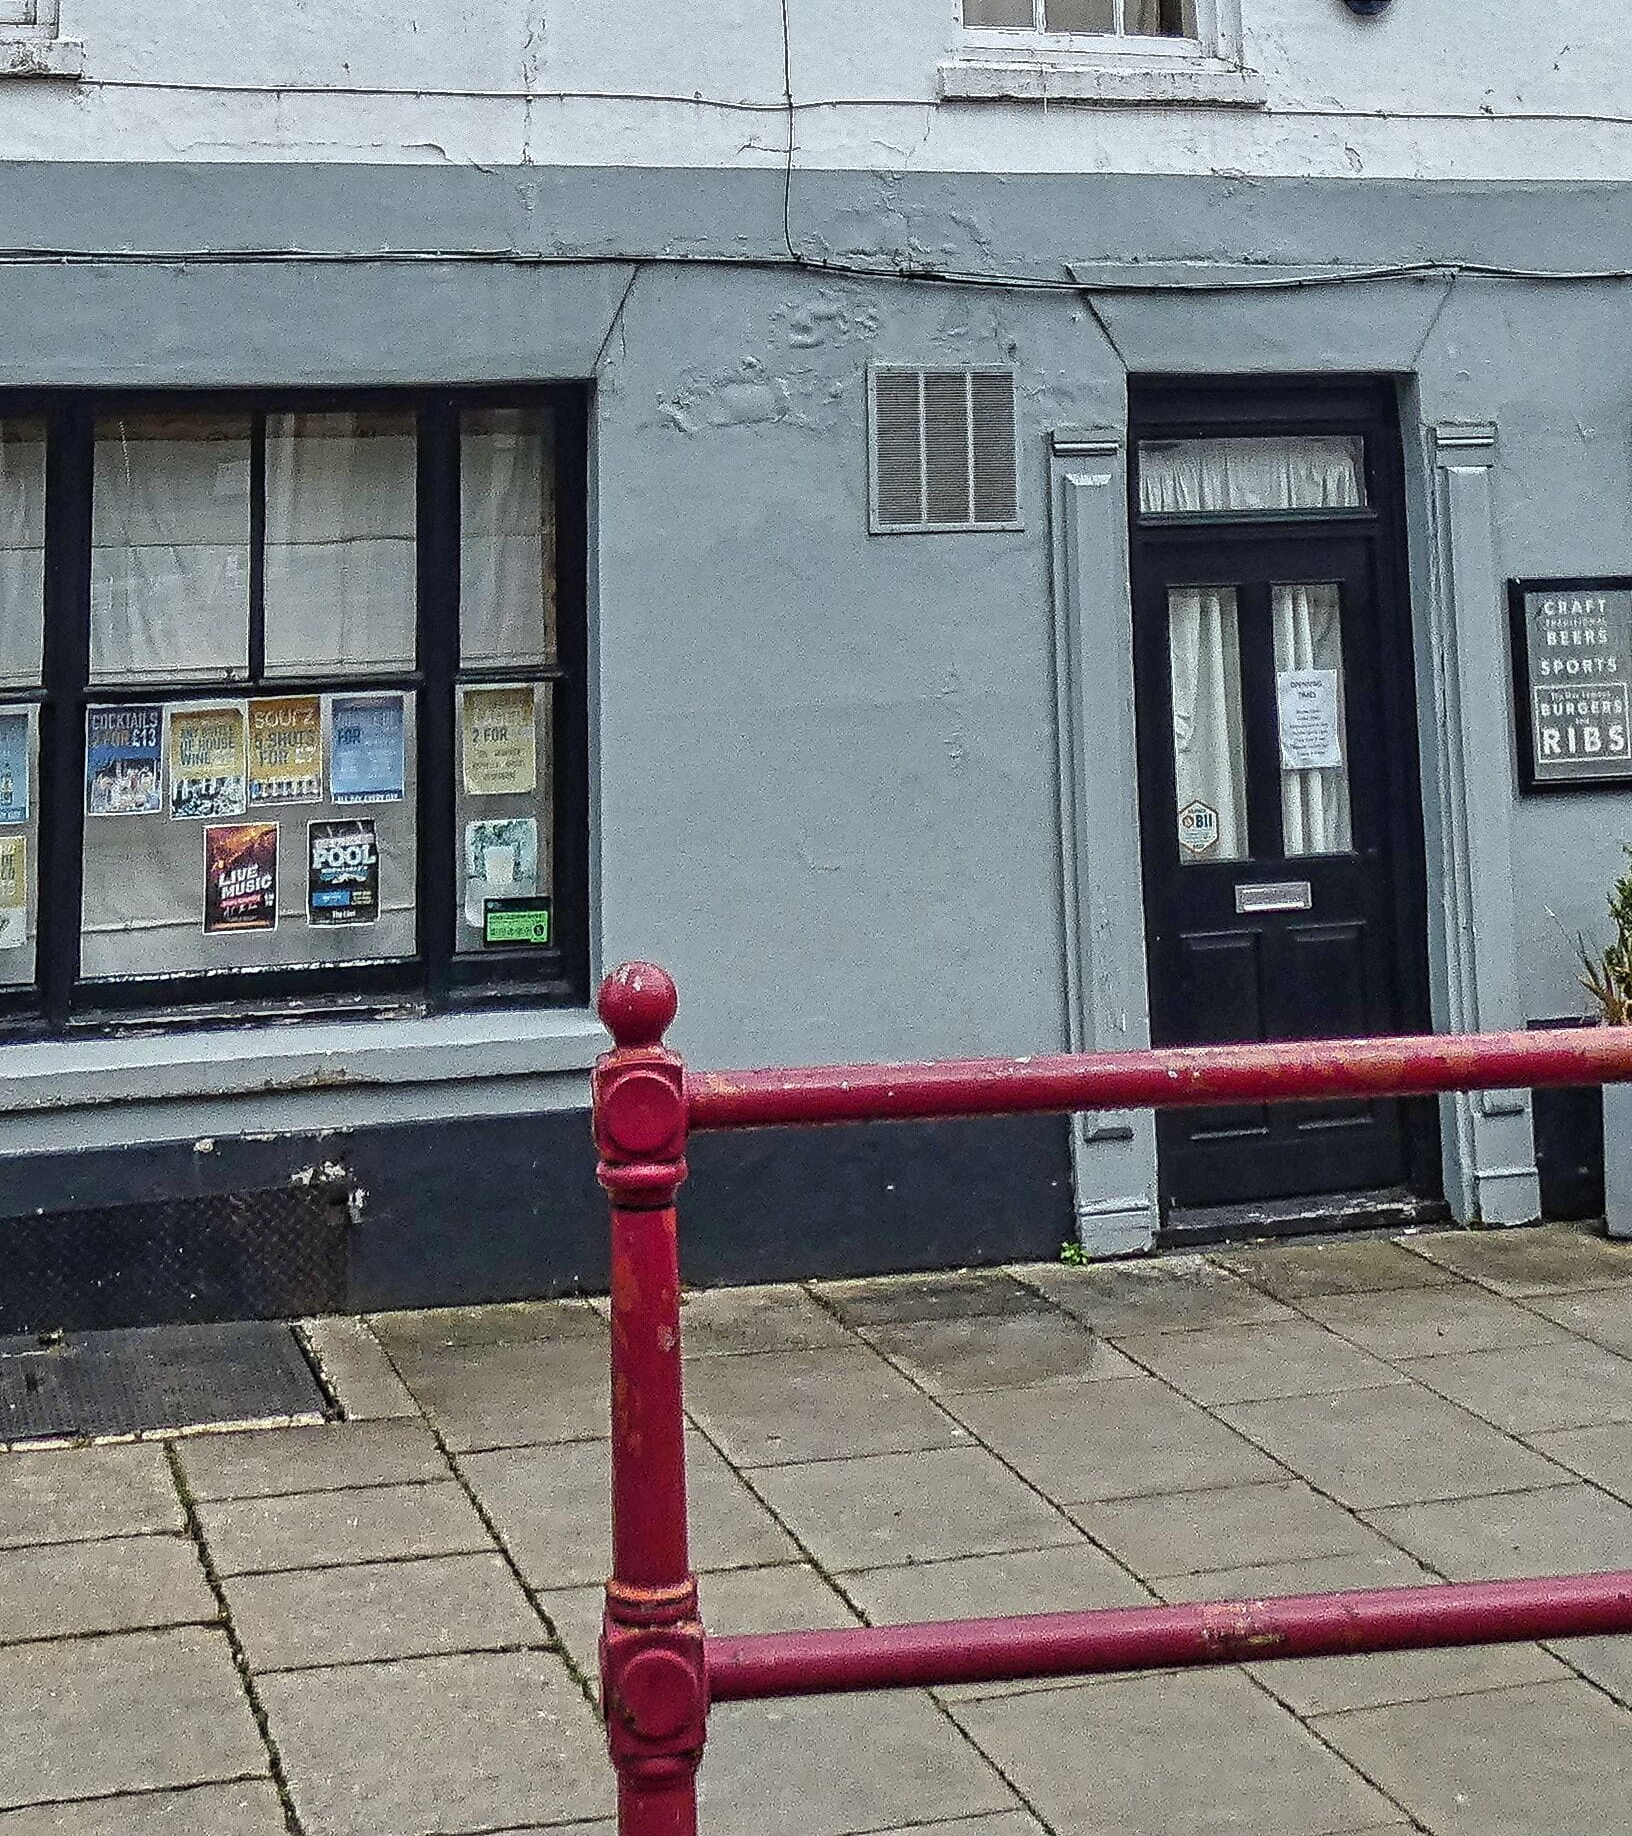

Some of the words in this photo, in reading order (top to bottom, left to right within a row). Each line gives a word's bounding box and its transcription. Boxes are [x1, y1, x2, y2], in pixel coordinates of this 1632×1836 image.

[1543, 599, 1607, 615] CRAFT
[1546, 629, 1609, 646] BEERS
[1540, 657, 1618, 676] SPORTS
[1540, 700, 1623, 717] BURGERS
[92, 711, 158, 730] COCKTAILS
[131, 728, 156, 747] £13
[483, 726, 508, 742] FOR
[1541, 724, 1626, 755] RIBS
[311, 844, 377, 870] POOL
[218, 863, 259, 887] LIVE
[221, 873, 273, 900] MUSIC
